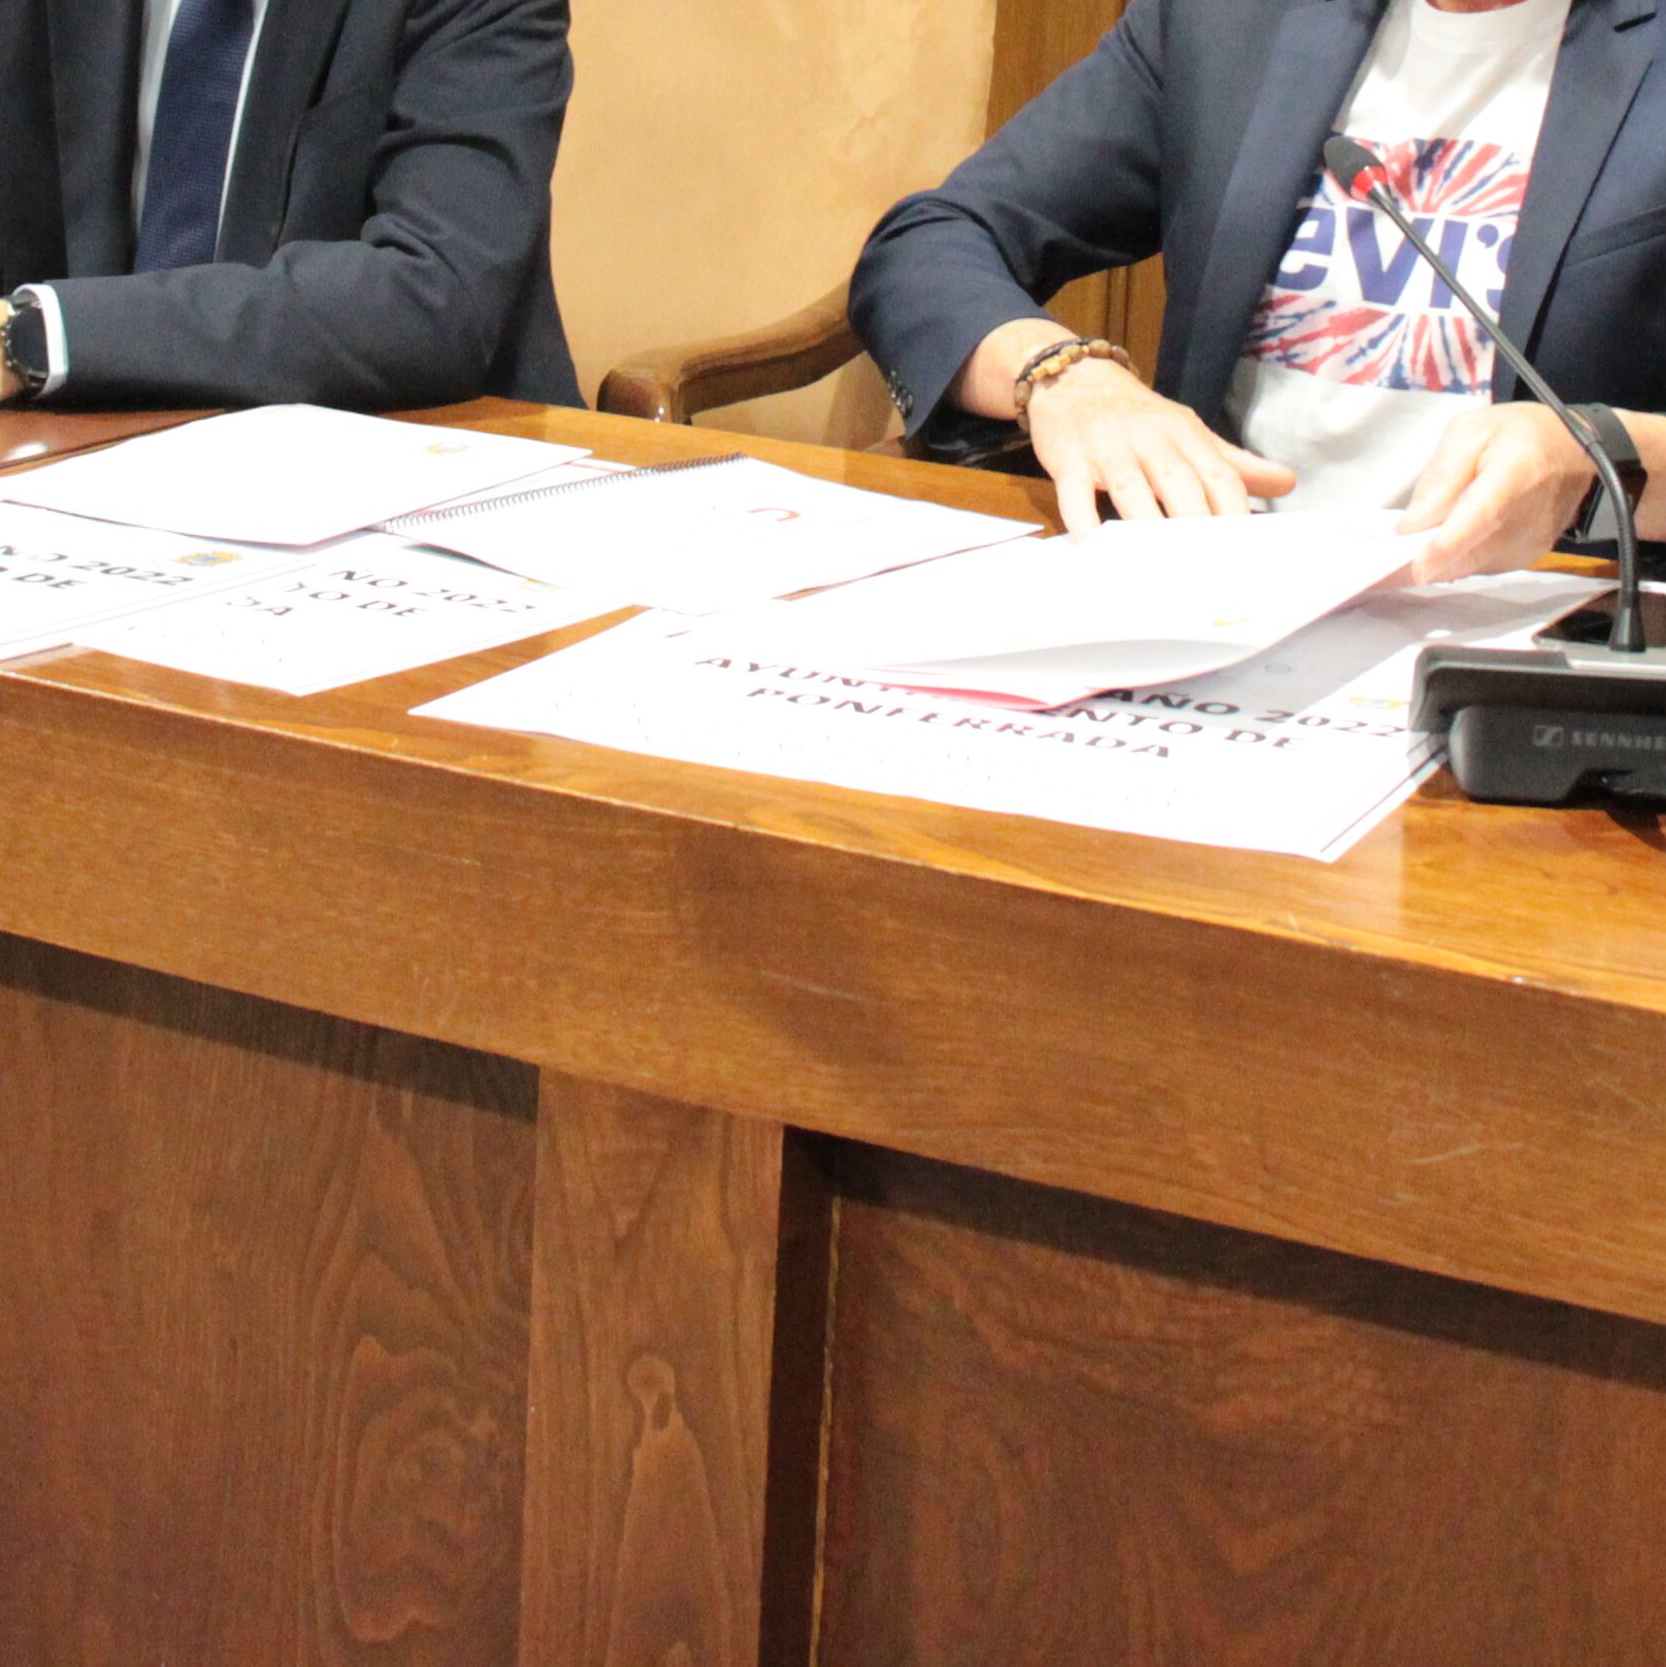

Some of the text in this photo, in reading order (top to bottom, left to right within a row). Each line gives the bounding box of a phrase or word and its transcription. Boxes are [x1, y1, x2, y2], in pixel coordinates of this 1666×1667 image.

[12, 572, 88, 590] DE
[69, 560, 195, 587] 2022
[355, 599, 430, 618] DE
[413, 587, 537, 614] 2022
[746, 687, 1171, 758] PONFERRADA
[1253, 709, 1408, 738] 2022
[1224, 728, 1307, 751] DE
